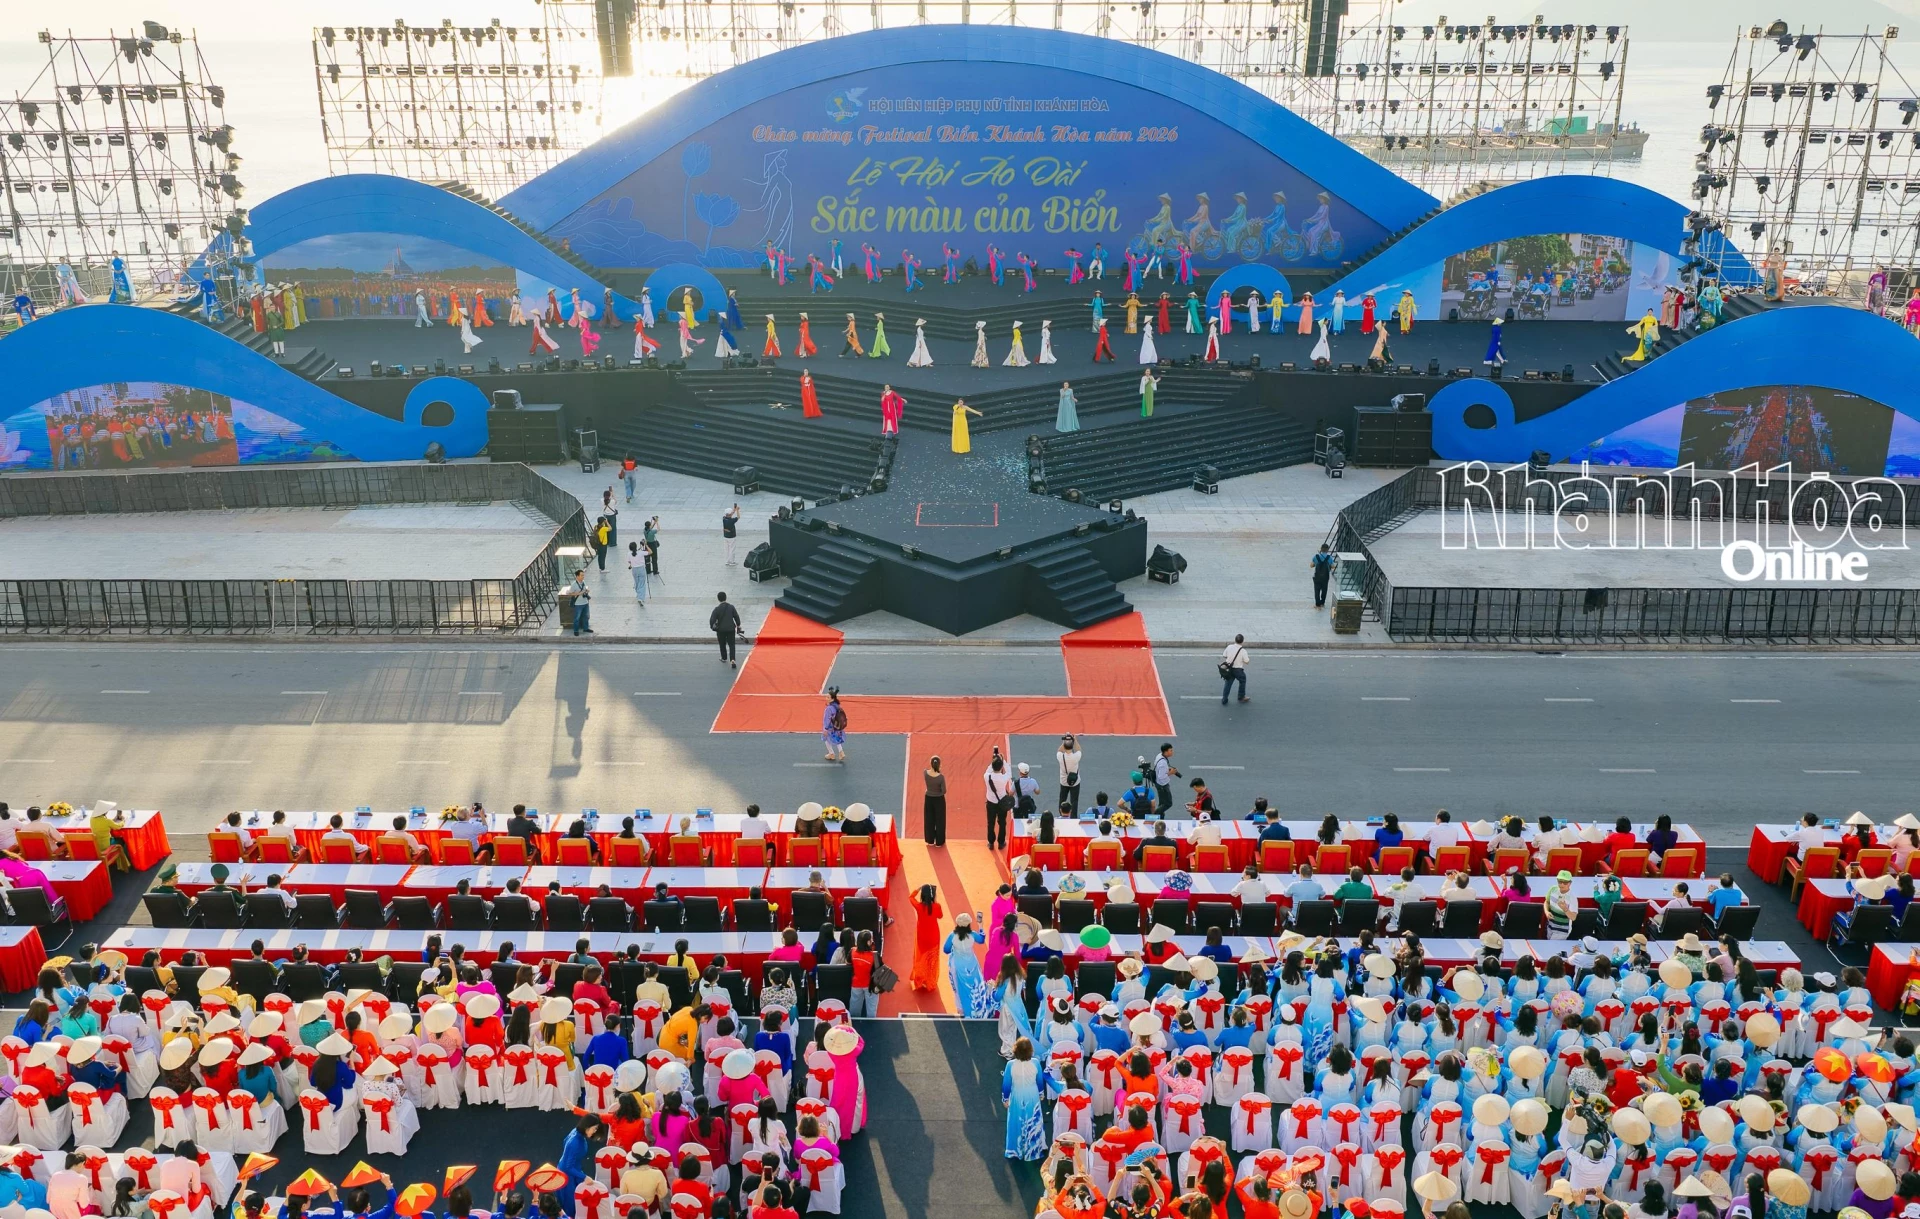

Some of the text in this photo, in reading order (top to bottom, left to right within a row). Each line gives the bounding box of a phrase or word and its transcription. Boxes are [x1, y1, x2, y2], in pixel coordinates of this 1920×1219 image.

[868, 97, 894, 114] HỘI
[896, 97, 922, 112] LIÊN
[924, 97, 953, 115] HIỆP
[954, 99, 982, 115] PHỤ
[984, 97, 1003, 112] NỮ
[1034, 97, 1078, 112] KHÁNH
[1080, 97, 1110, 112] HÒA
[752, 124, 1179, 146] Chào mừng Festival Biển Khánh Hòa năm 2026
[847, 156, 886, 187] Lễ
[889, 156, 961, 190] Hội
[960, 155, 1016, 187] Áo
[810, 187, 1122, 234] Sắc màu của Biển
